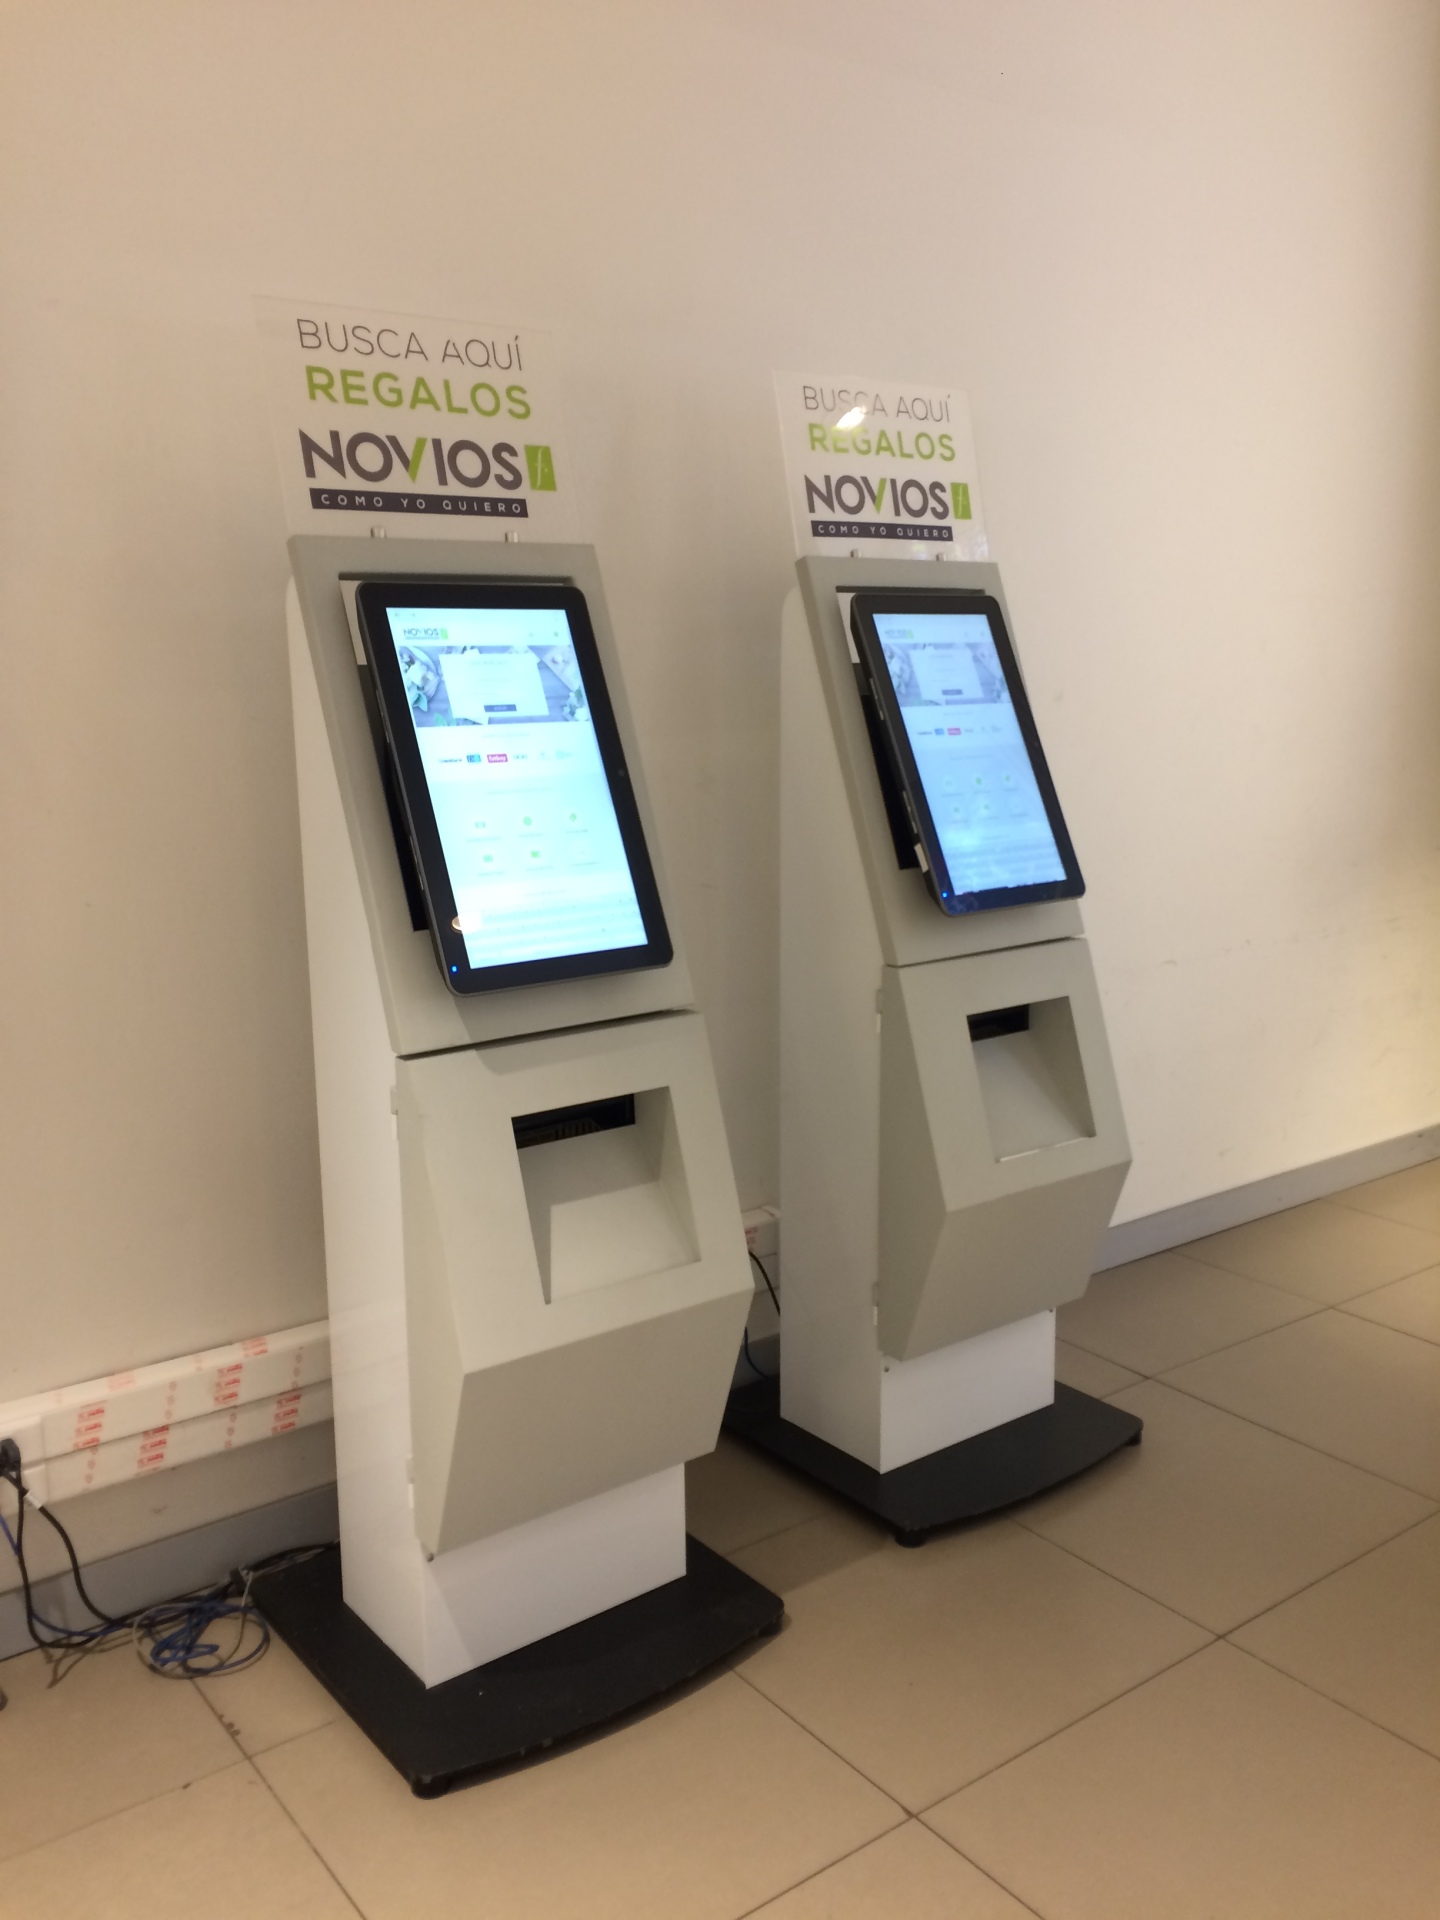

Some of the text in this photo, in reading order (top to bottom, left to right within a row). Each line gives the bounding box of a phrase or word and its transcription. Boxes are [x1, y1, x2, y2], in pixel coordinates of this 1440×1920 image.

[297, 318, 522, 371] BUSCA AQUÍ
[305, 365, 531, 420] REGALOS
[803, 385, 951, 423] BUSCA AQUÍ
[298, 428, 522, 490] NOVIOS
[808, 423, 956, 462] REGALOS
[321, 494, 521, 514] COMO YO QUIERO
[804, 474, 949, 520] NOVIOS
[818, 525, 949, 538] COMO YO QUIERO
